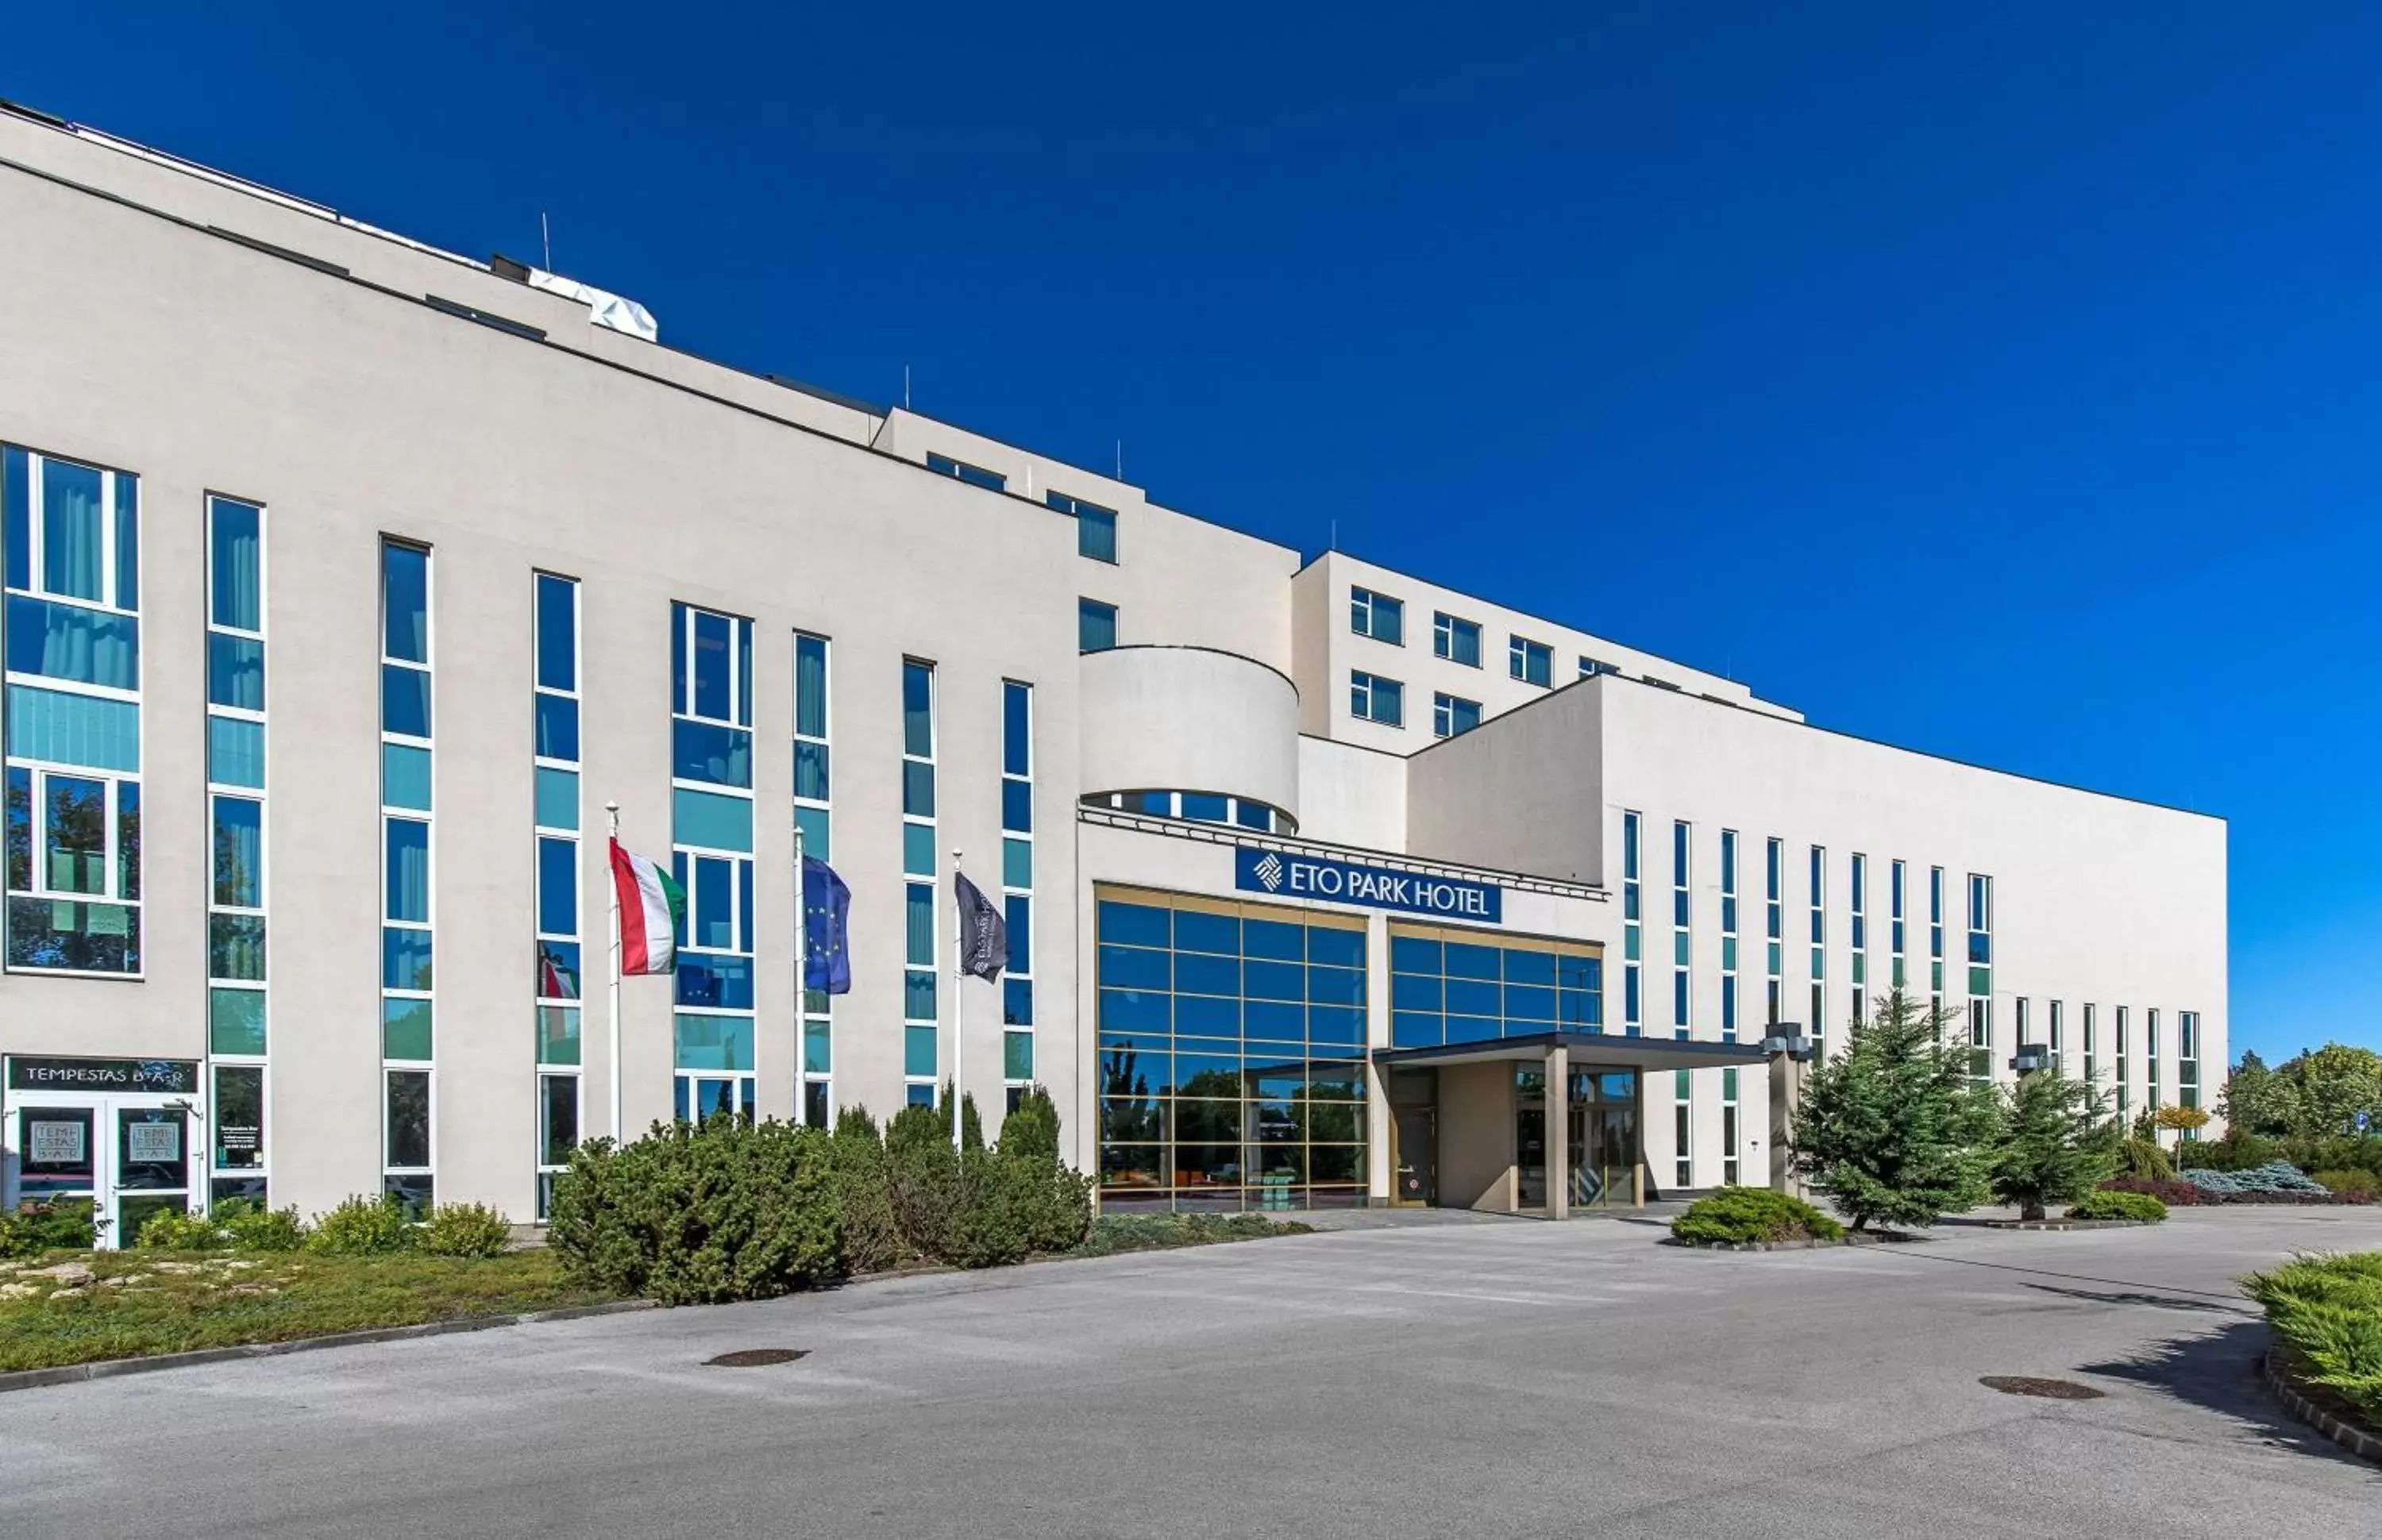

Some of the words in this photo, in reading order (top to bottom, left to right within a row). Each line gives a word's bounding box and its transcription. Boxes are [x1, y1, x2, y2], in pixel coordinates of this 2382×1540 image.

[1290, 863, 1343, 895] ETO
[1348, 871, 1409, 904] PARK
[1414, 880, 1490, 915] HOTEL
[27, 1068, 126, 1082] TEMPESTAS
[37, 1138, 77, 1147] ESTAS
